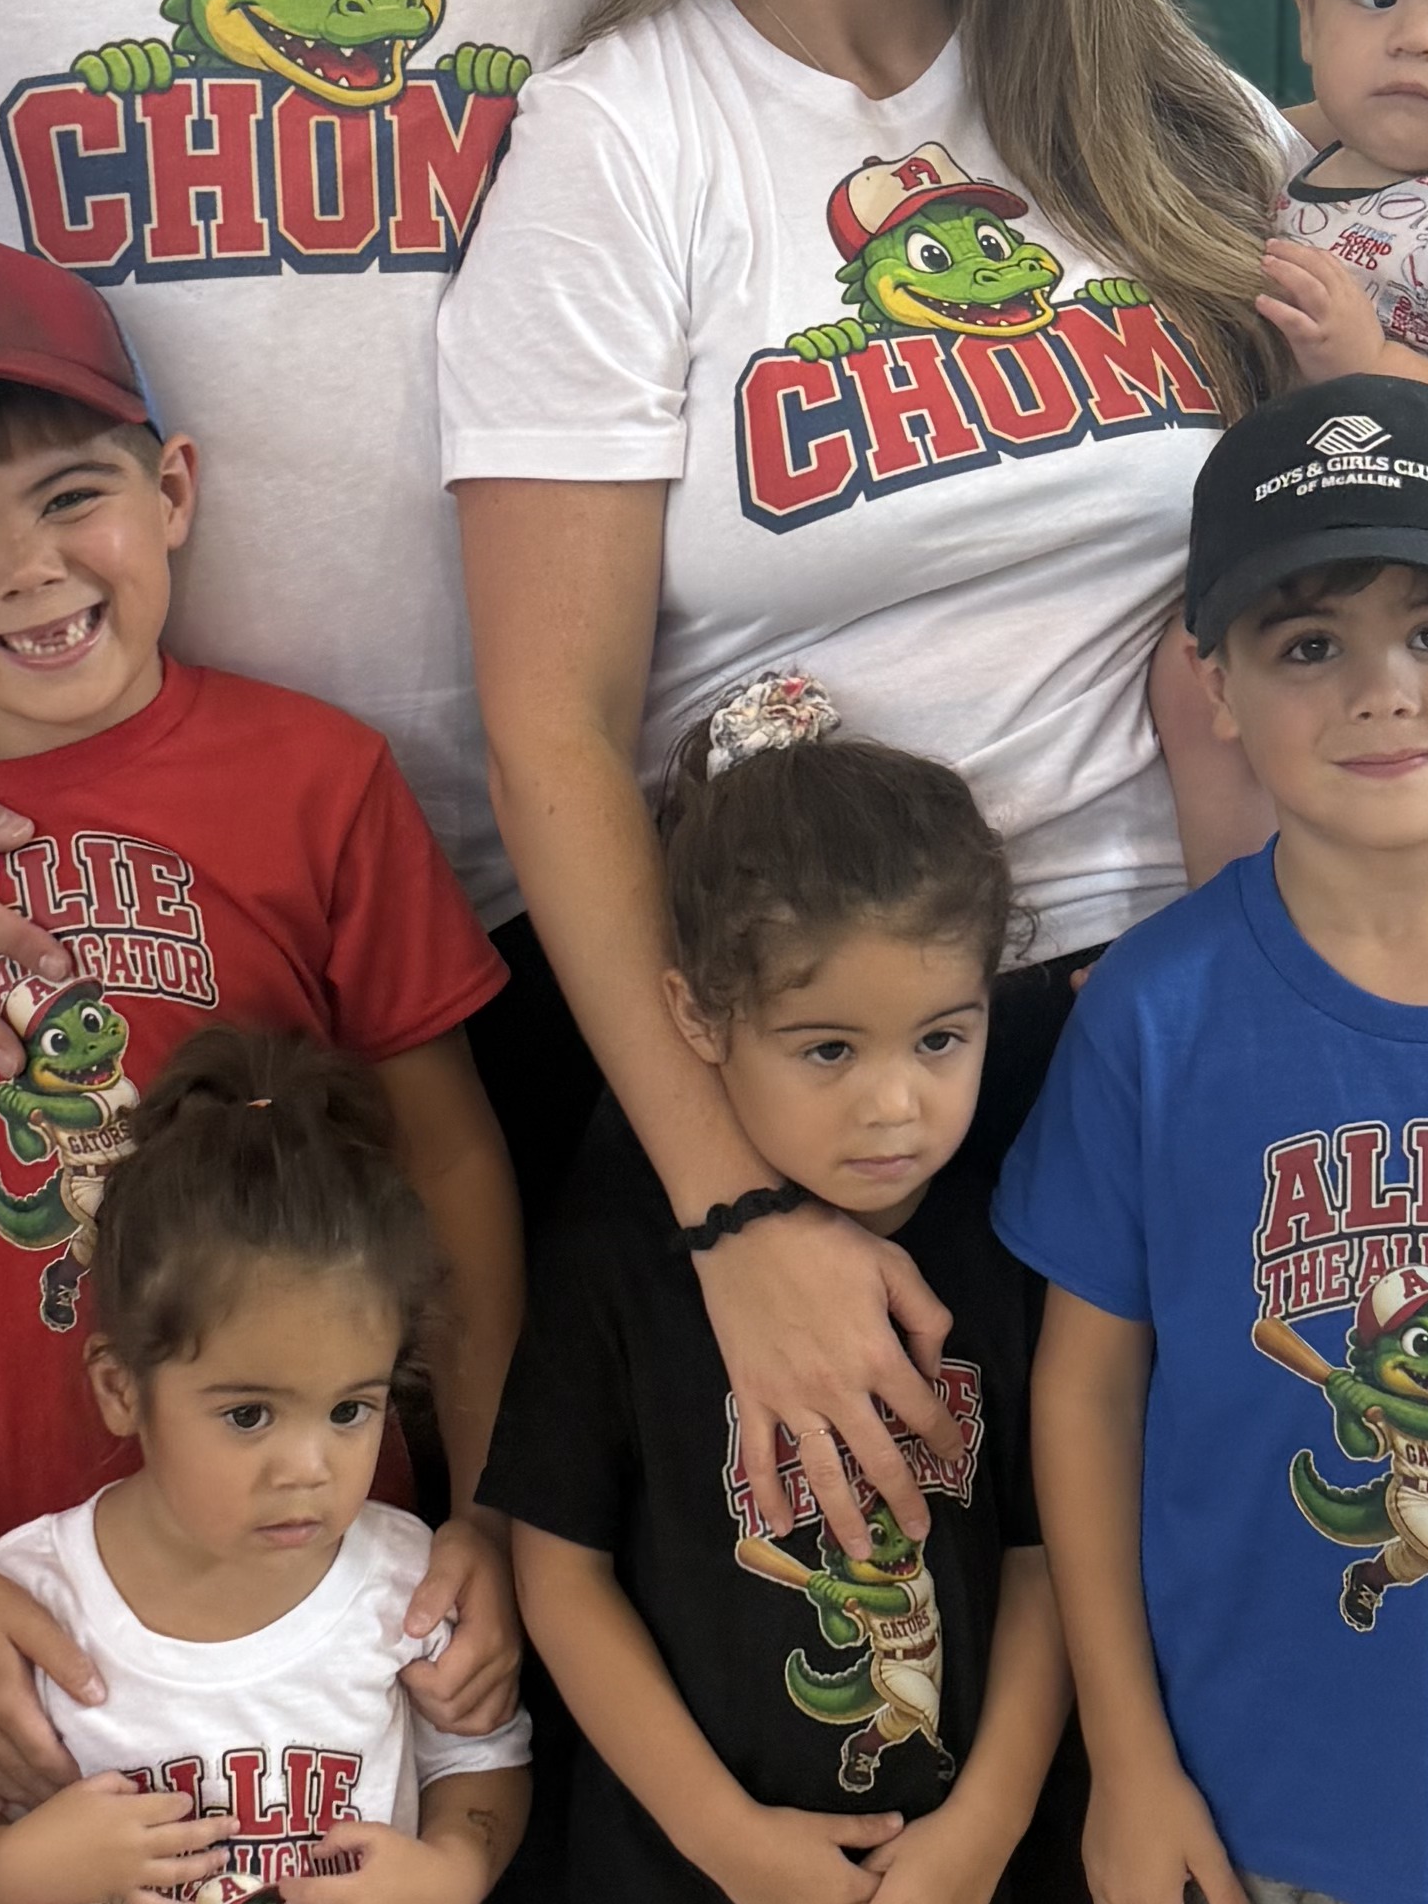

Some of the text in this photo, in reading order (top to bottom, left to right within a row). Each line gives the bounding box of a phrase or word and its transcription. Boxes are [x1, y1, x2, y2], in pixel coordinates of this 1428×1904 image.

[891, 156, 943, 192] A
[1255, 466, 1303, 502] BOYS
[1306, 461, 1324, 478] &
[1327, 455, 1390, 471] GIRLS
[1296, 473, 1403, 496] OF McALLEN
[1262, 1241, 1352, 1319] THE
[735, 1467, 817, 1537] TE
[879, 1609, 933, 1641] GATORS
[219, 1875, 247, 1903] A
